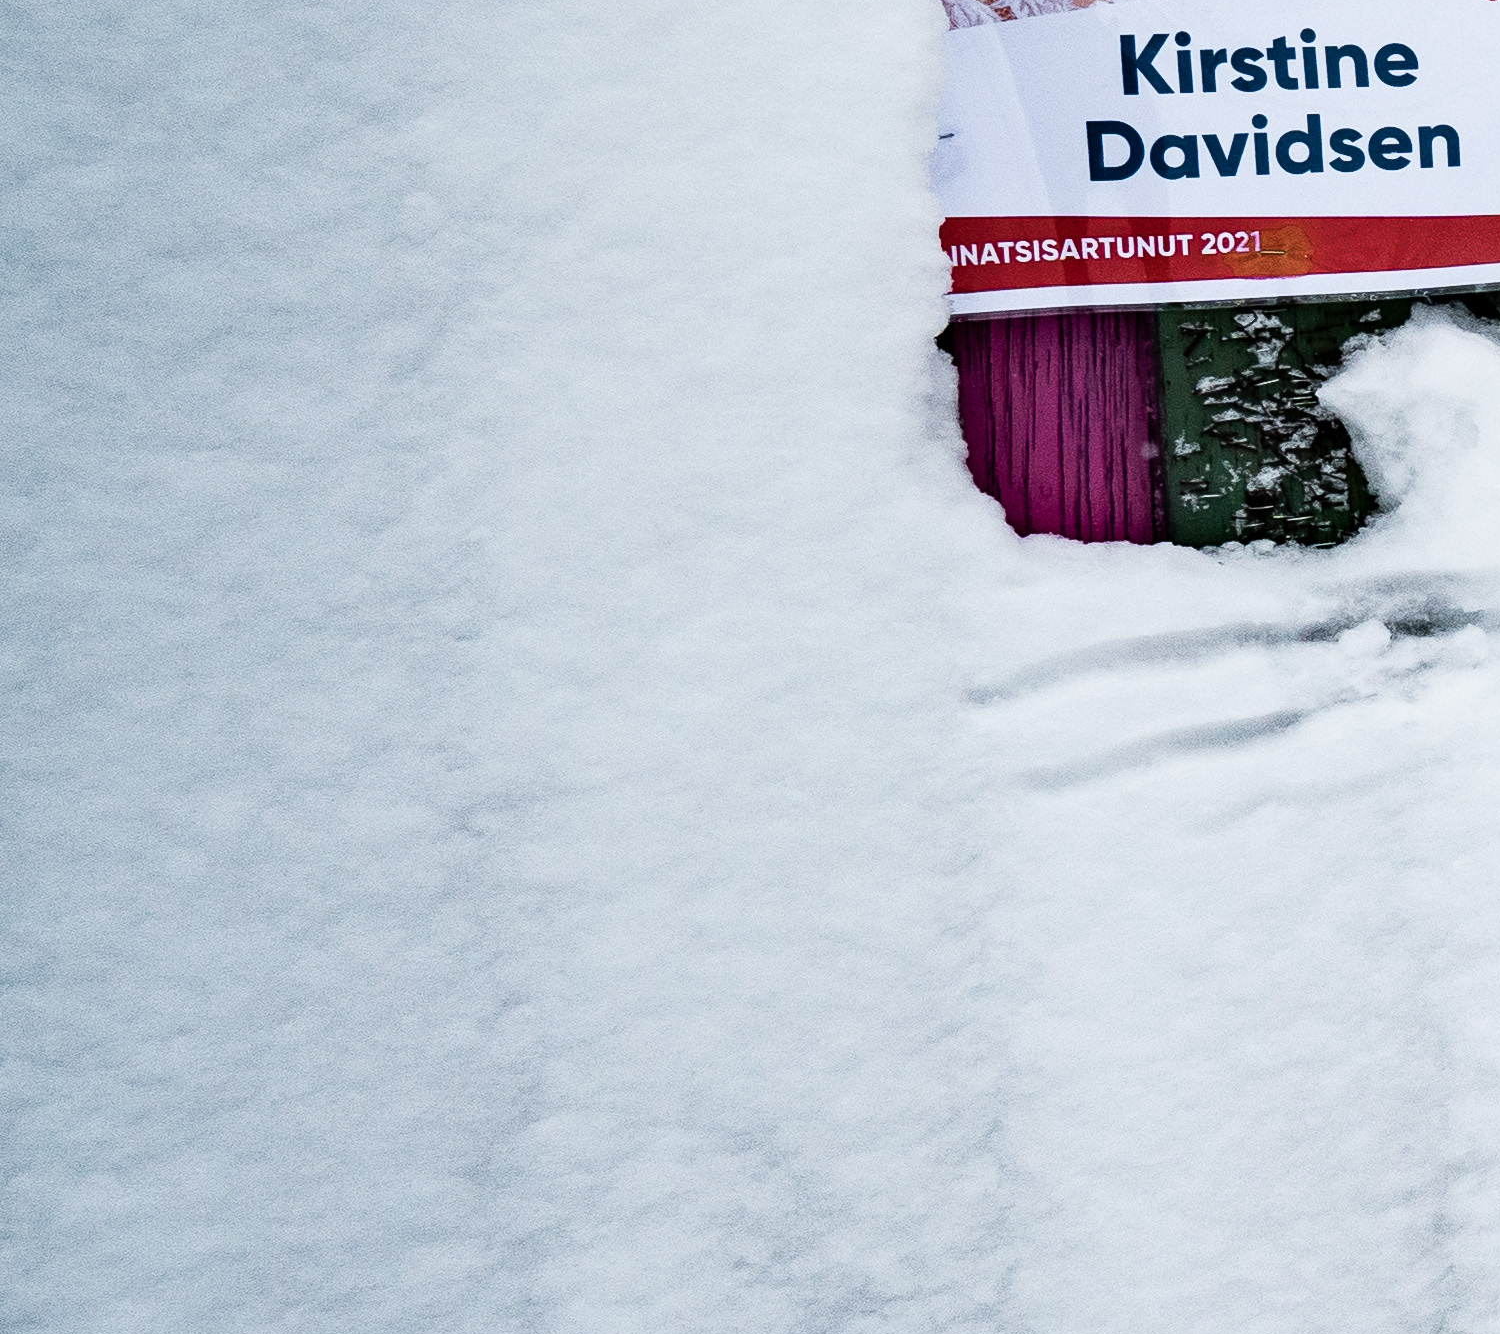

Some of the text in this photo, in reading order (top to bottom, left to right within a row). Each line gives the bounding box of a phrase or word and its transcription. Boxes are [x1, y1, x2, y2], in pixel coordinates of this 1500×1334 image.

[1119, 28, 1419, 95] Kirstine
[1085, 113, 1461, 183] Davidsen
[950, 231, 1262, 266] INATSISARTUNUT 2021
